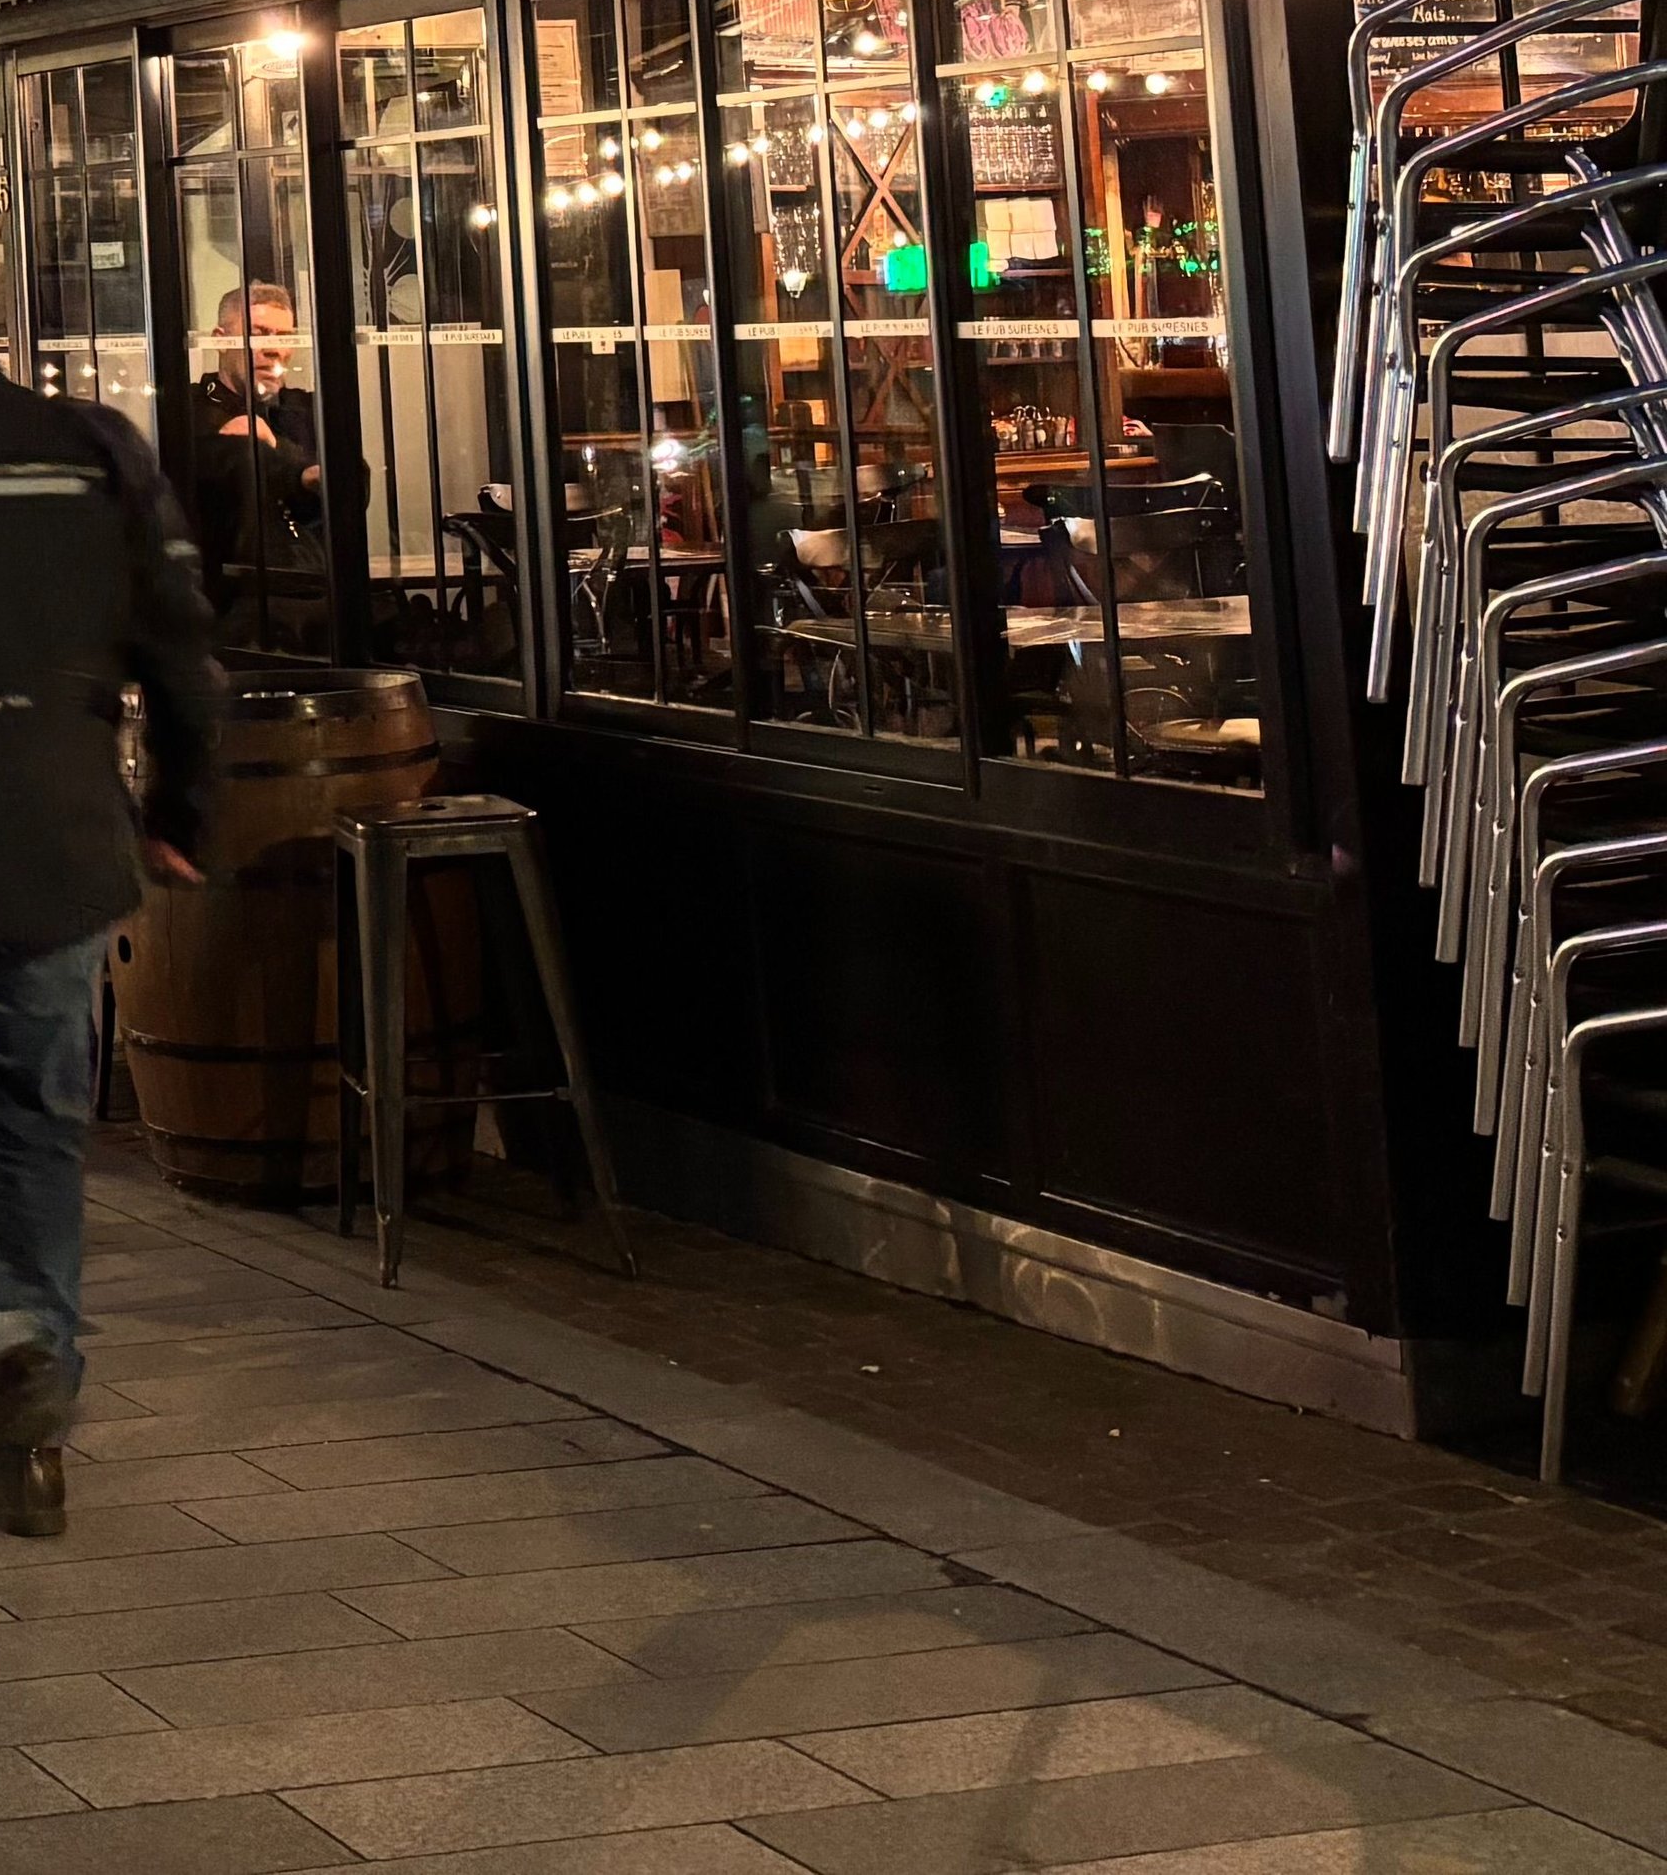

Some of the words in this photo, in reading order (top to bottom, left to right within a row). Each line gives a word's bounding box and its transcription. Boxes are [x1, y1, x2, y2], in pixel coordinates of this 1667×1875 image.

[972, 323, 984, 335] LE
[986, 322, 1006, 335] PUB
[1007, 322, 1060, 335] SURESNES
[1112, 322, 1126, 334] LE
[1128, 321, 1149, 333] PUB
[1151, 320, 1209, 333] SURESNES
